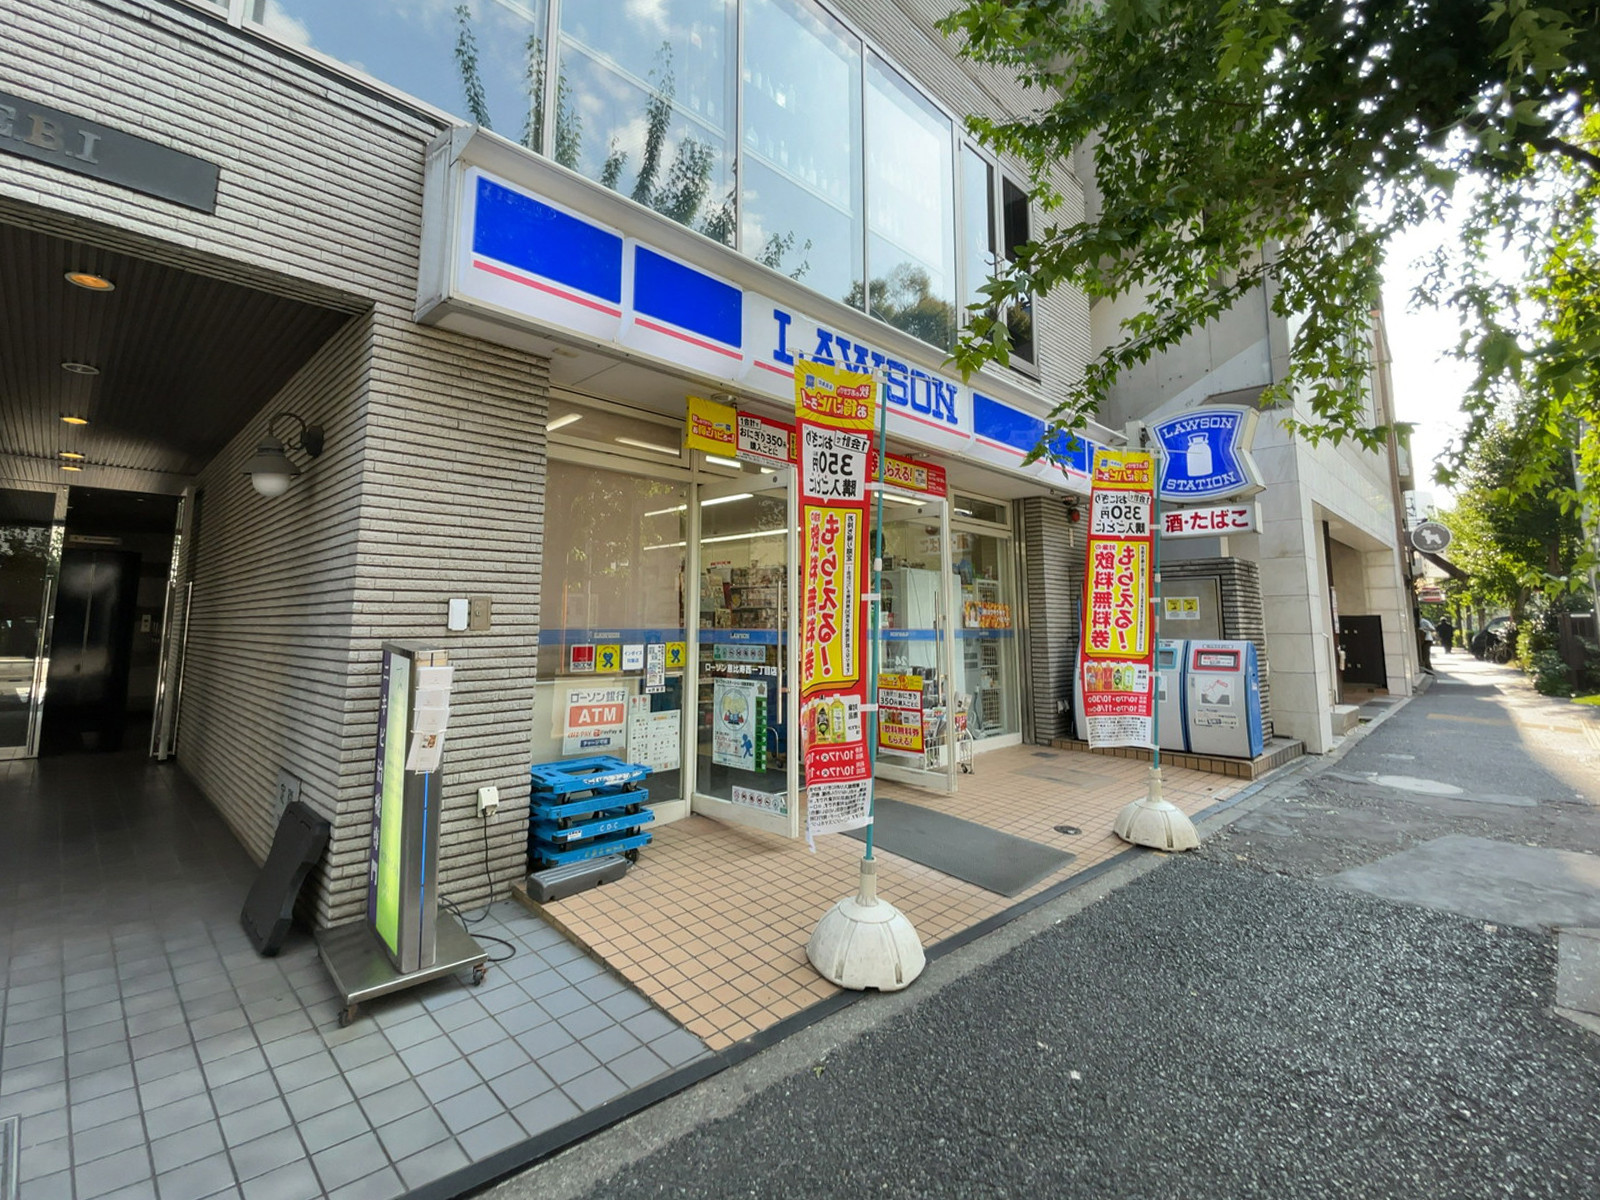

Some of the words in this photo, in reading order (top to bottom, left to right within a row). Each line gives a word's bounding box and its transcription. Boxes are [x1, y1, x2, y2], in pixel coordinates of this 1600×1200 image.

[772, 308, 958, 424] LAWSON
[1162, 416, 1234, 439] LAWSON
[1166, 471, 1237, 491] STATION
[1165, 508, 1249, 533] 酒・たばこ
[570, 690, 626, 704] ローソン銀行
[578, 707, 617, 724] ATM
